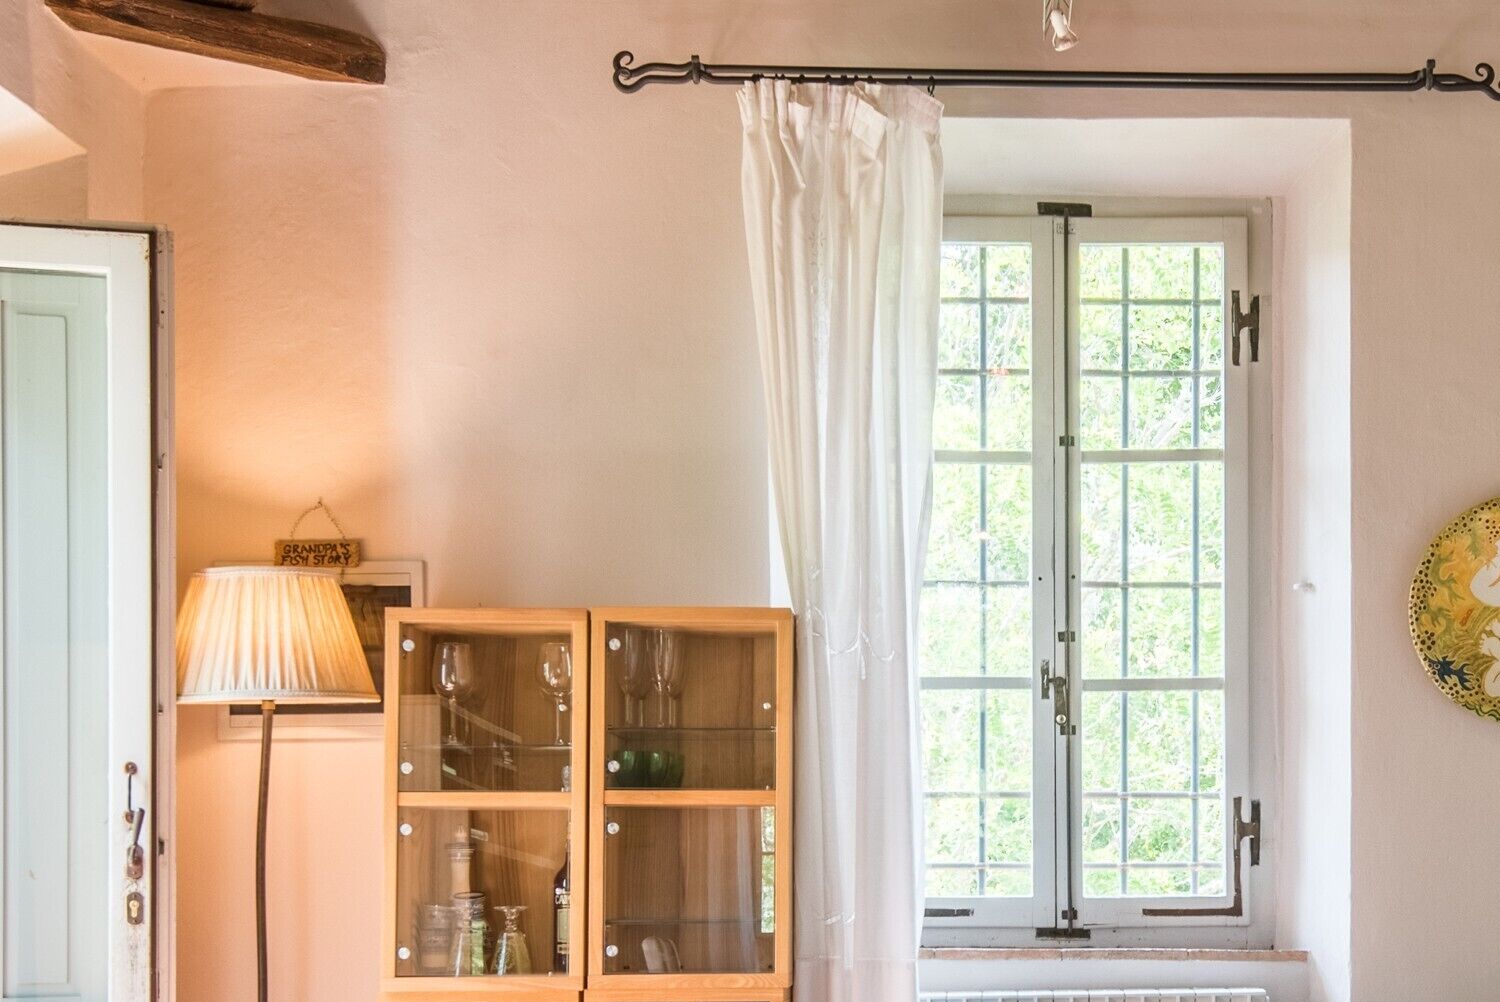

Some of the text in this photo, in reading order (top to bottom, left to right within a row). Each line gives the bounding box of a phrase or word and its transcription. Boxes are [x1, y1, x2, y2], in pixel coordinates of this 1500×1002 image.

[283, 543, 350, 555] GRANDPA'S
[281, 555, 351, 565] FISH STORY
